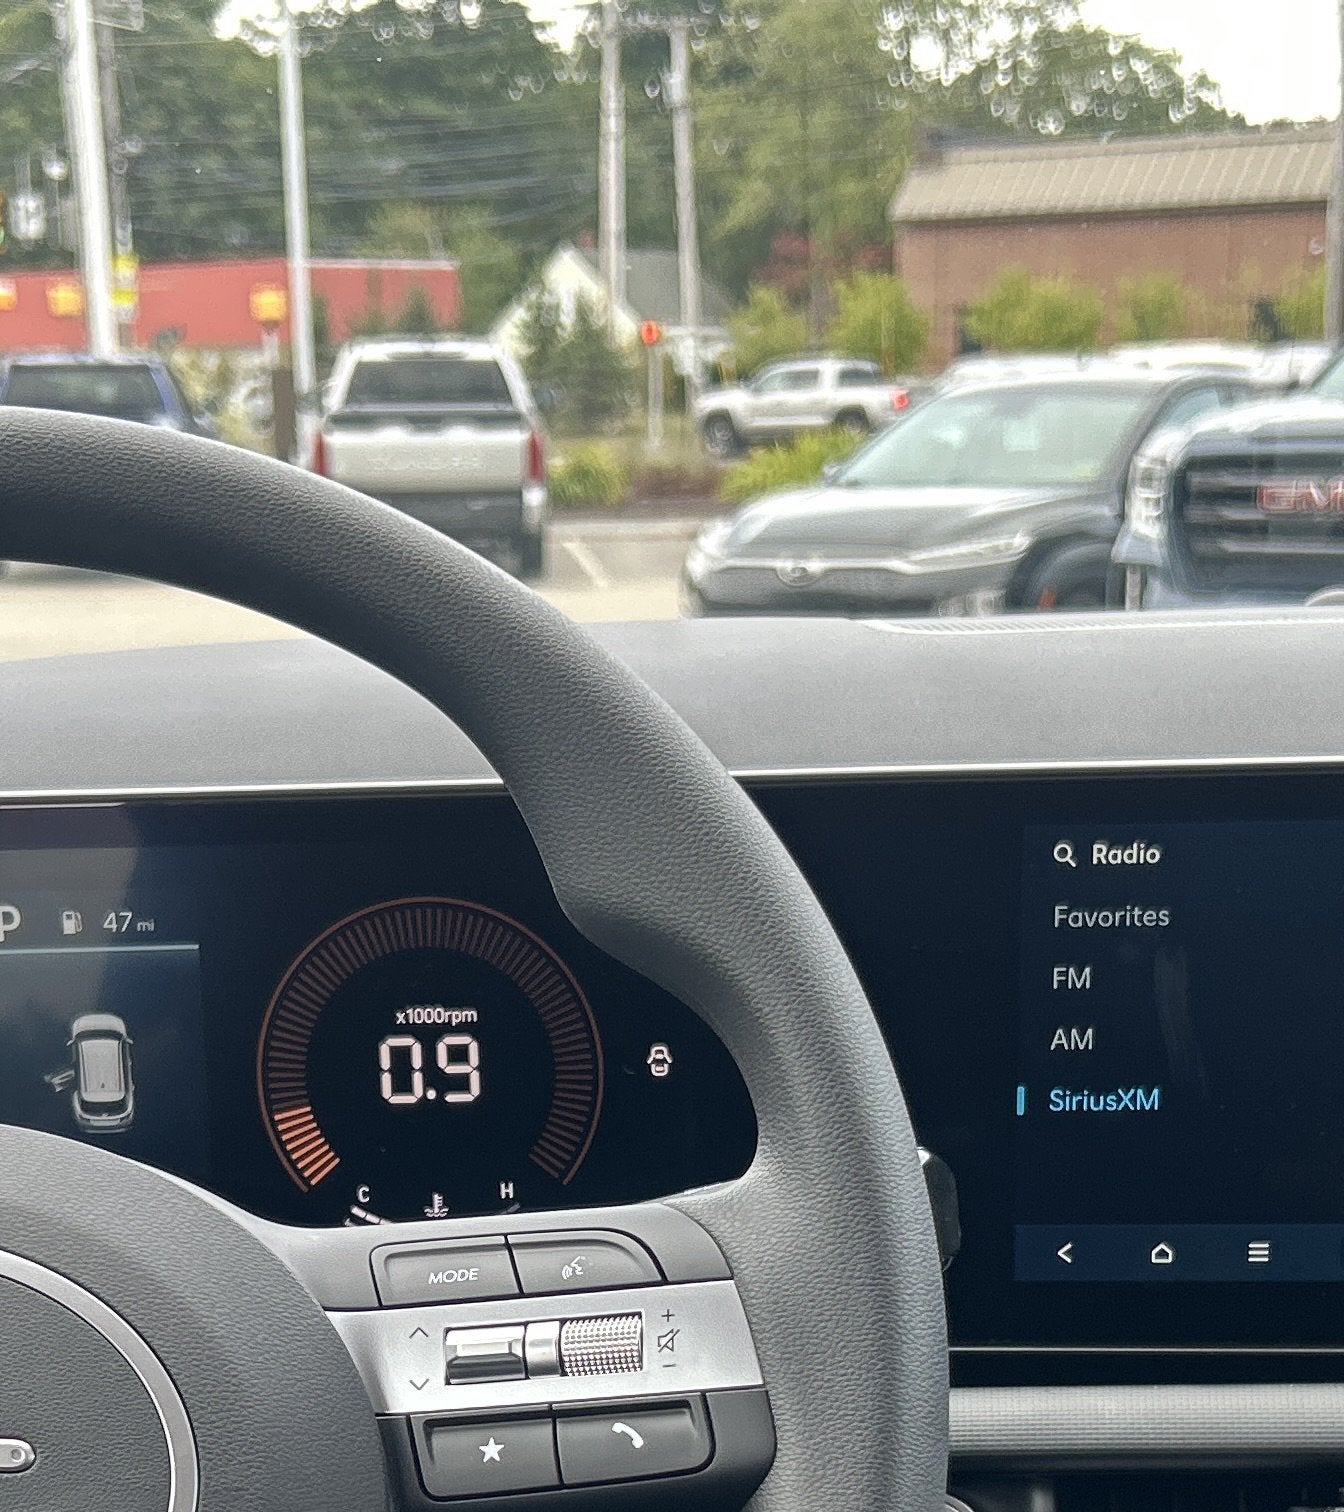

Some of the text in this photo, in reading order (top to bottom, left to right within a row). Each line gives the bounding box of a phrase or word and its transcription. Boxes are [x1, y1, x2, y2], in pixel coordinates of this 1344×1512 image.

[1092, 843, 1161, 866] Radio
[102, 912, 155, 931] 47 mi
[1054, 904, 1170, 928] Favorites
[1052, 967, 1092, 989] FM
[396, 1008, 478, 1026] x1000rpm
[1050, 1028, 1094, 1050] AM
[379, 1036, 481, 1104] 0.9
[1049, 1086, 1160, 1111] SiriusXM
[357, 1185, 371, 1203] C
[500, 1182, 514, 1199] H
[428, 1268, 478, 1285] MODE
